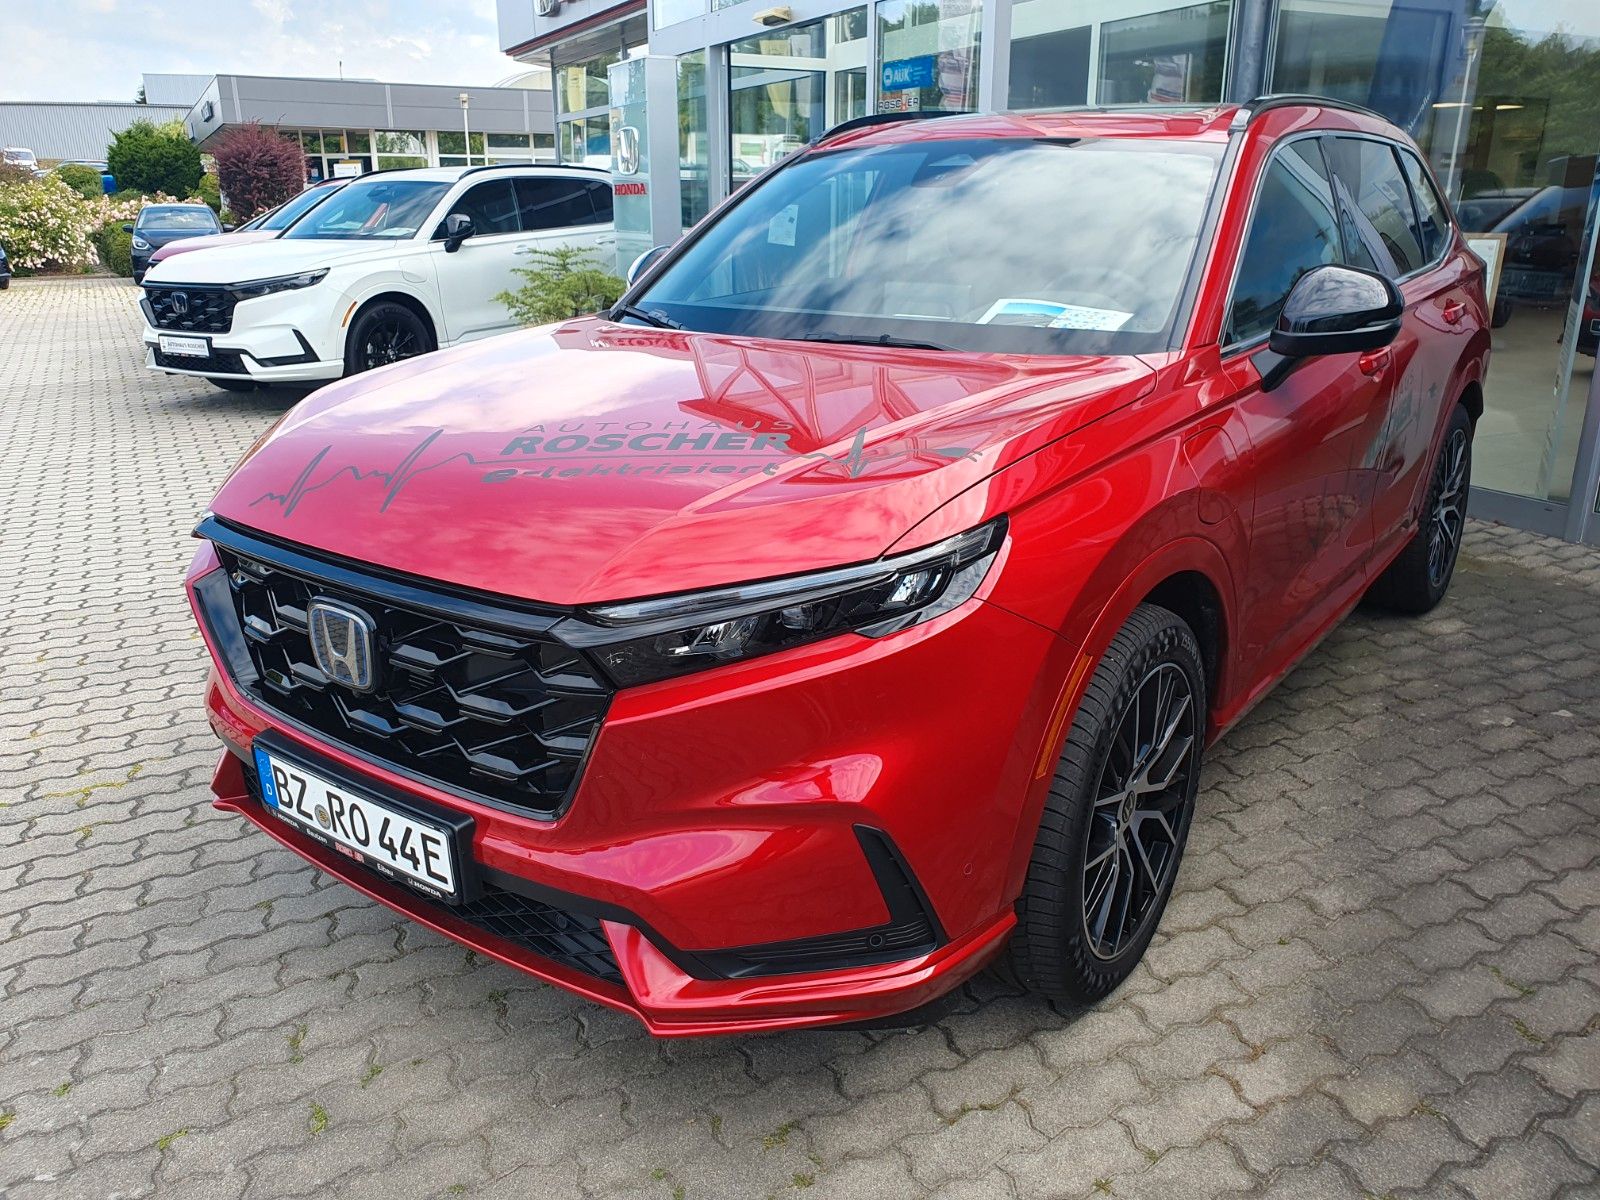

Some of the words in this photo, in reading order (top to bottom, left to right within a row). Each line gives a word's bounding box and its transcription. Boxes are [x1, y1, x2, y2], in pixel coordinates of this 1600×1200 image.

[614, 183, 647, 195] HONDA
[521, 421, 795, 433] AUTOHAUS
[499, 432, 792, 455] ROSCHER
[413, 881, 443, 898] HONDA
